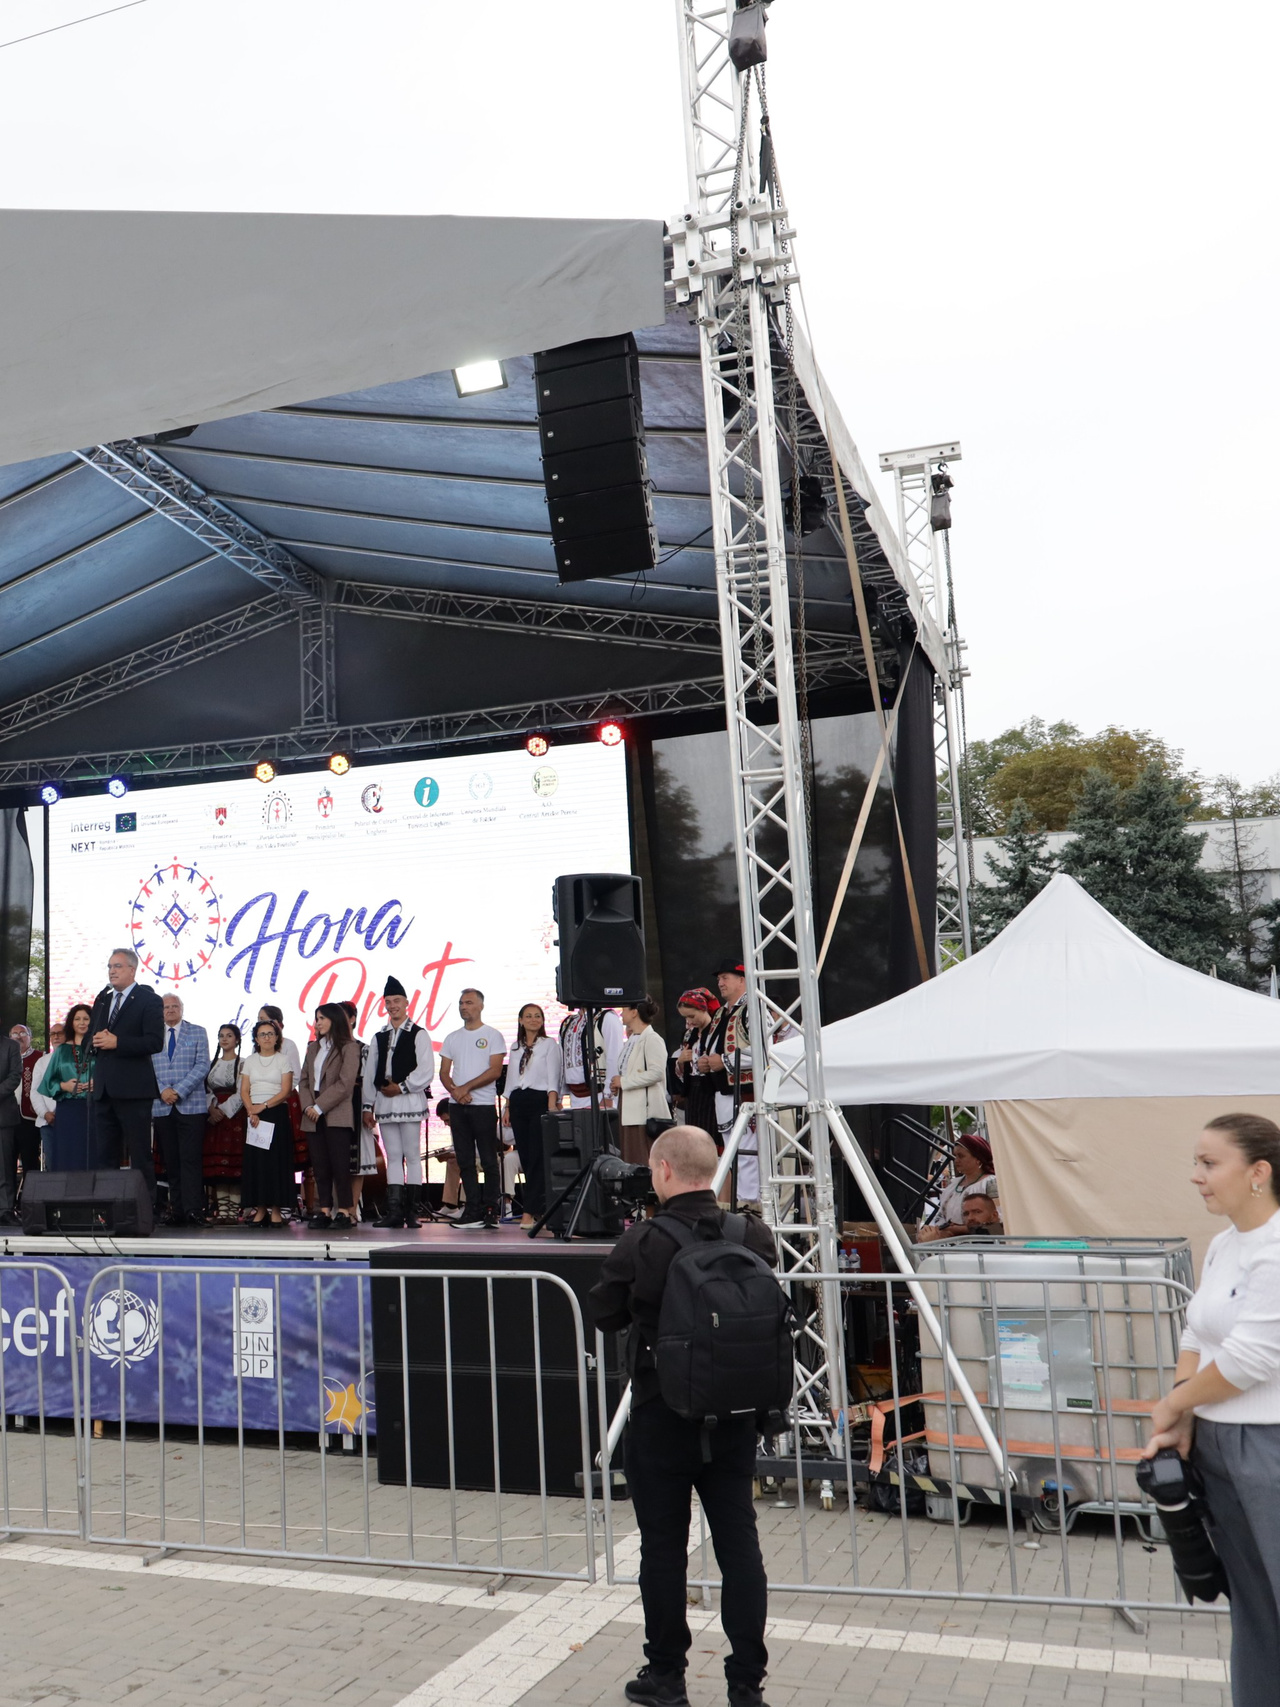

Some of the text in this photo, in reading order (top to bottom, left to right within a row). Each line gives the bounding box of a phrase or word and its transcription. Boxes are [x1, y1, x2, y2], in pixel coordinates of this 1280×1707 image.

[70, 821, 111, 833] Interreg
[70, 841, 96, 853] NEXT
[224, 889, 415, 994] Hora
